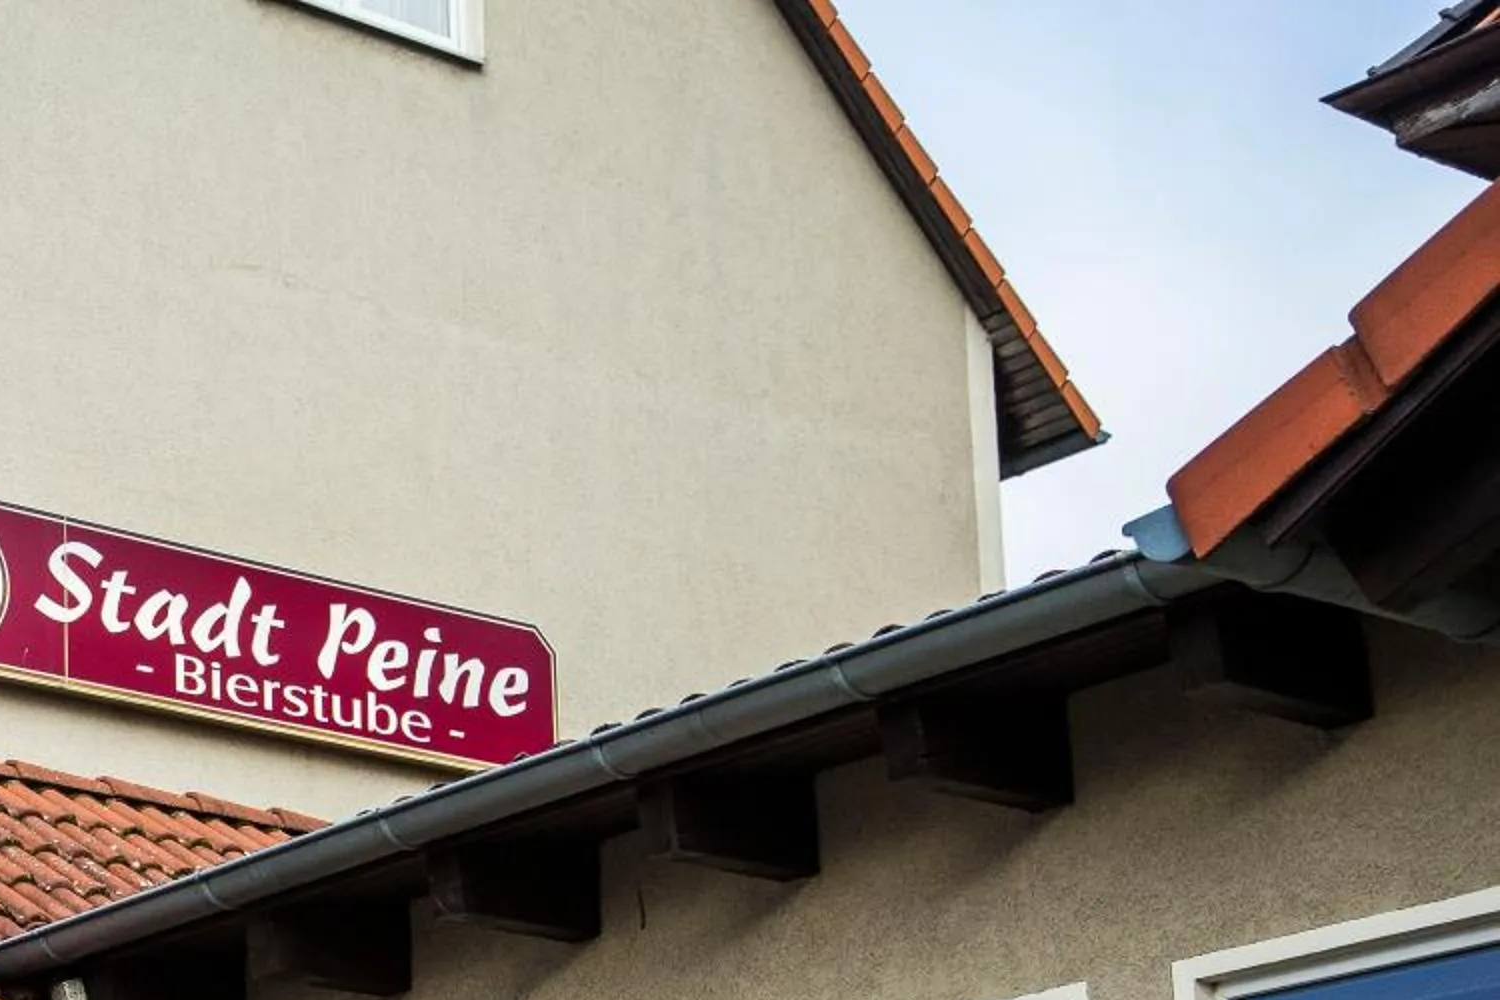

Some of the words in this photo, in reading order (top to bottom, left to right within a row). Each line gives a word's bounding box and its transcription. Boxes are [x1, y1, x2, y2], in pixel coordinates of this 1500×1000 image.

[35, 541, 285, 667] Stadt
[317, 603, 530, 718] Peine
[175, 652, 432, 743] Bierstube
